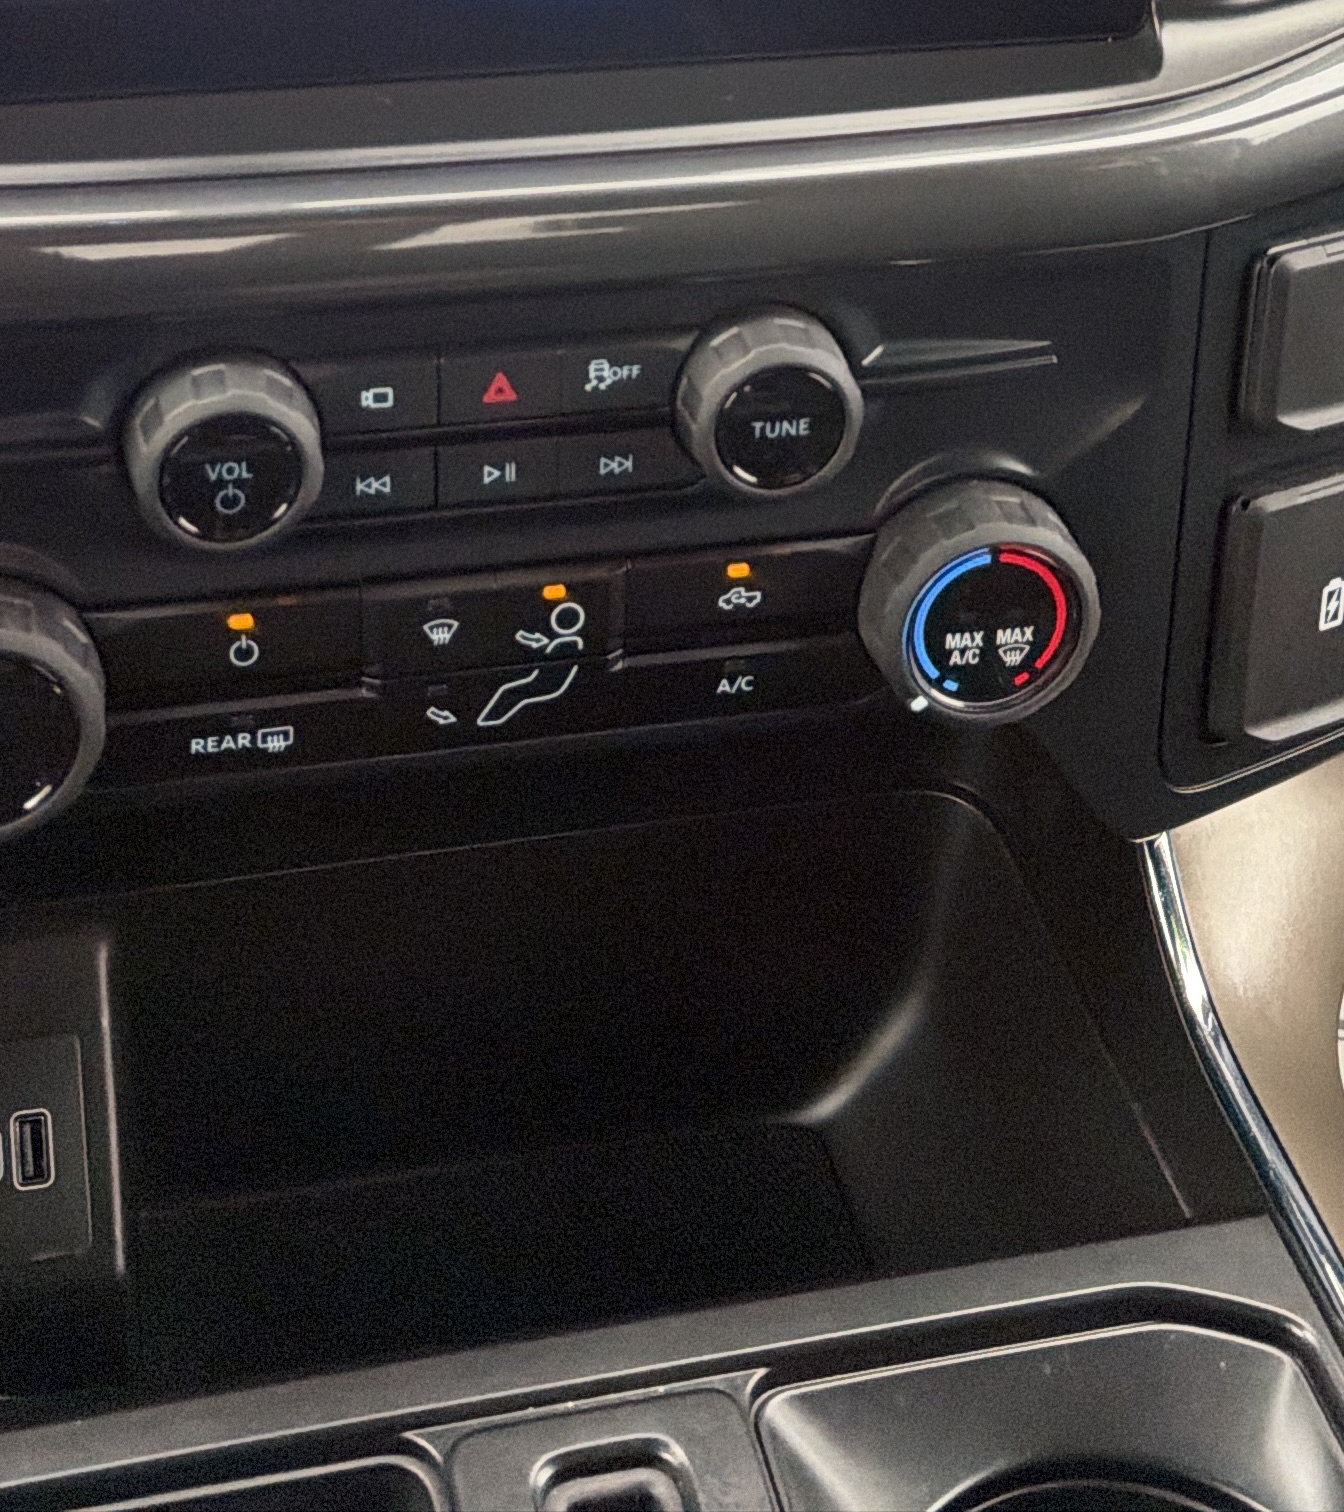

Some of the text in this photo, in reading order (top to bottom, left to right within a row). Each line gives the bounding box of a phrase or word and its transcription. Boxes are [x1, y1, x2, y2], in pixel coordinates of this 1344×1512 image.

[609, 363, 641, 380] OFF
[751, 417, 811, 439] TUNE
[205, 461, 253, 481] VOL
[945, 630, 984, 650] MAX
[996, 625, 1034, 645] MAX
[949, 648, 980, 666] A/C
[716, 675, 754, 694] A/C
[191, 732, 251, 754] REAR
